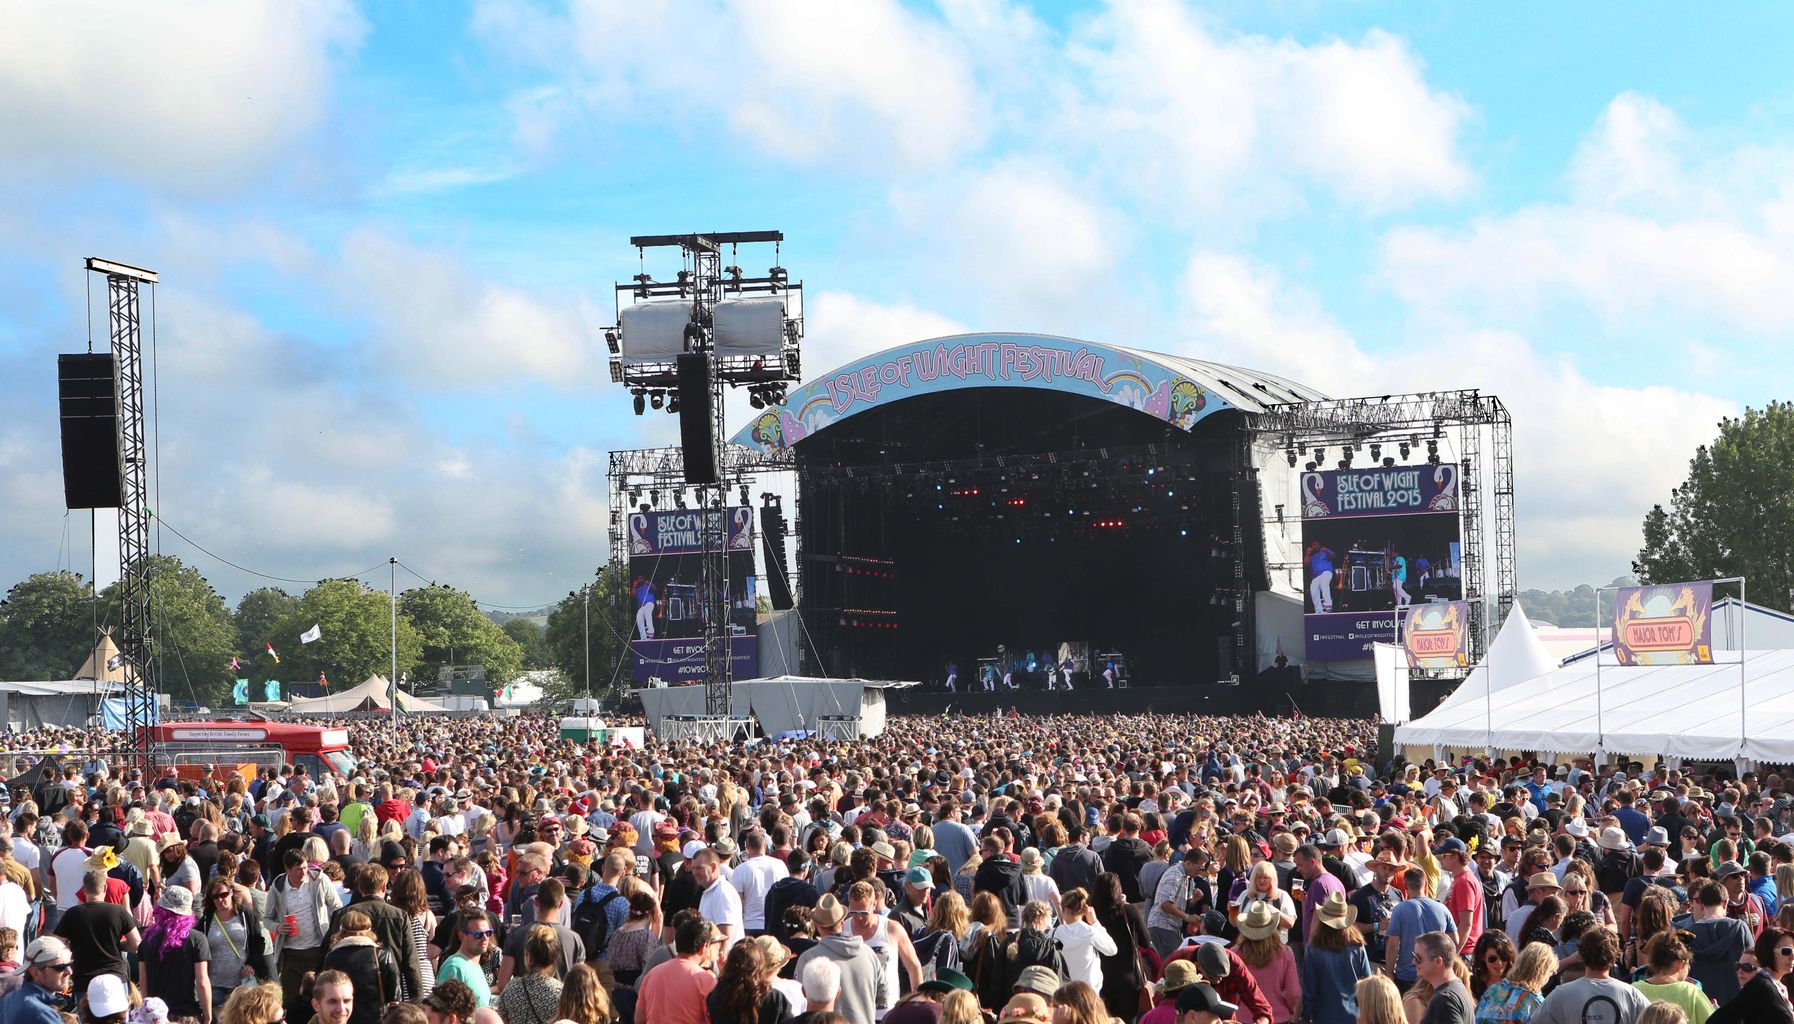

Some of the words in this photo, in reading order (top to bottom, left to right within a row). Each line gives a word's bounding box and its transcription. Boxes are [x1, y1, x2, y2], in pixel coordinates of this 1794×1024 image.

[826, 365, 881, 414] ISLE
[880, 357, 912, 388] OF
[913, 343, 999, 381] WIGHT
[1000, 343, 1112, 393] FESTIVAL
[1336, 475, 1360, 493] ISLE
[1360, 473, 1380, 490] OF
[1381, 471, 1420, 491] WIGHT
[1337, 491, 1386, 512] FESTIVAL
[1386, 490, 1422, 507] 2015
[675, 515, 692, 530] OF
[657, 531, 697, 549] FESTIVAL
[1355, 620, 1370, 629] GET
[1372, 619, 1405, 629] INVOLVE
[1632, 627, 1656, 643] MAJOR
[1657, 626, 1682, 642] TOM'S
[673, 646, 685, 655] GET
